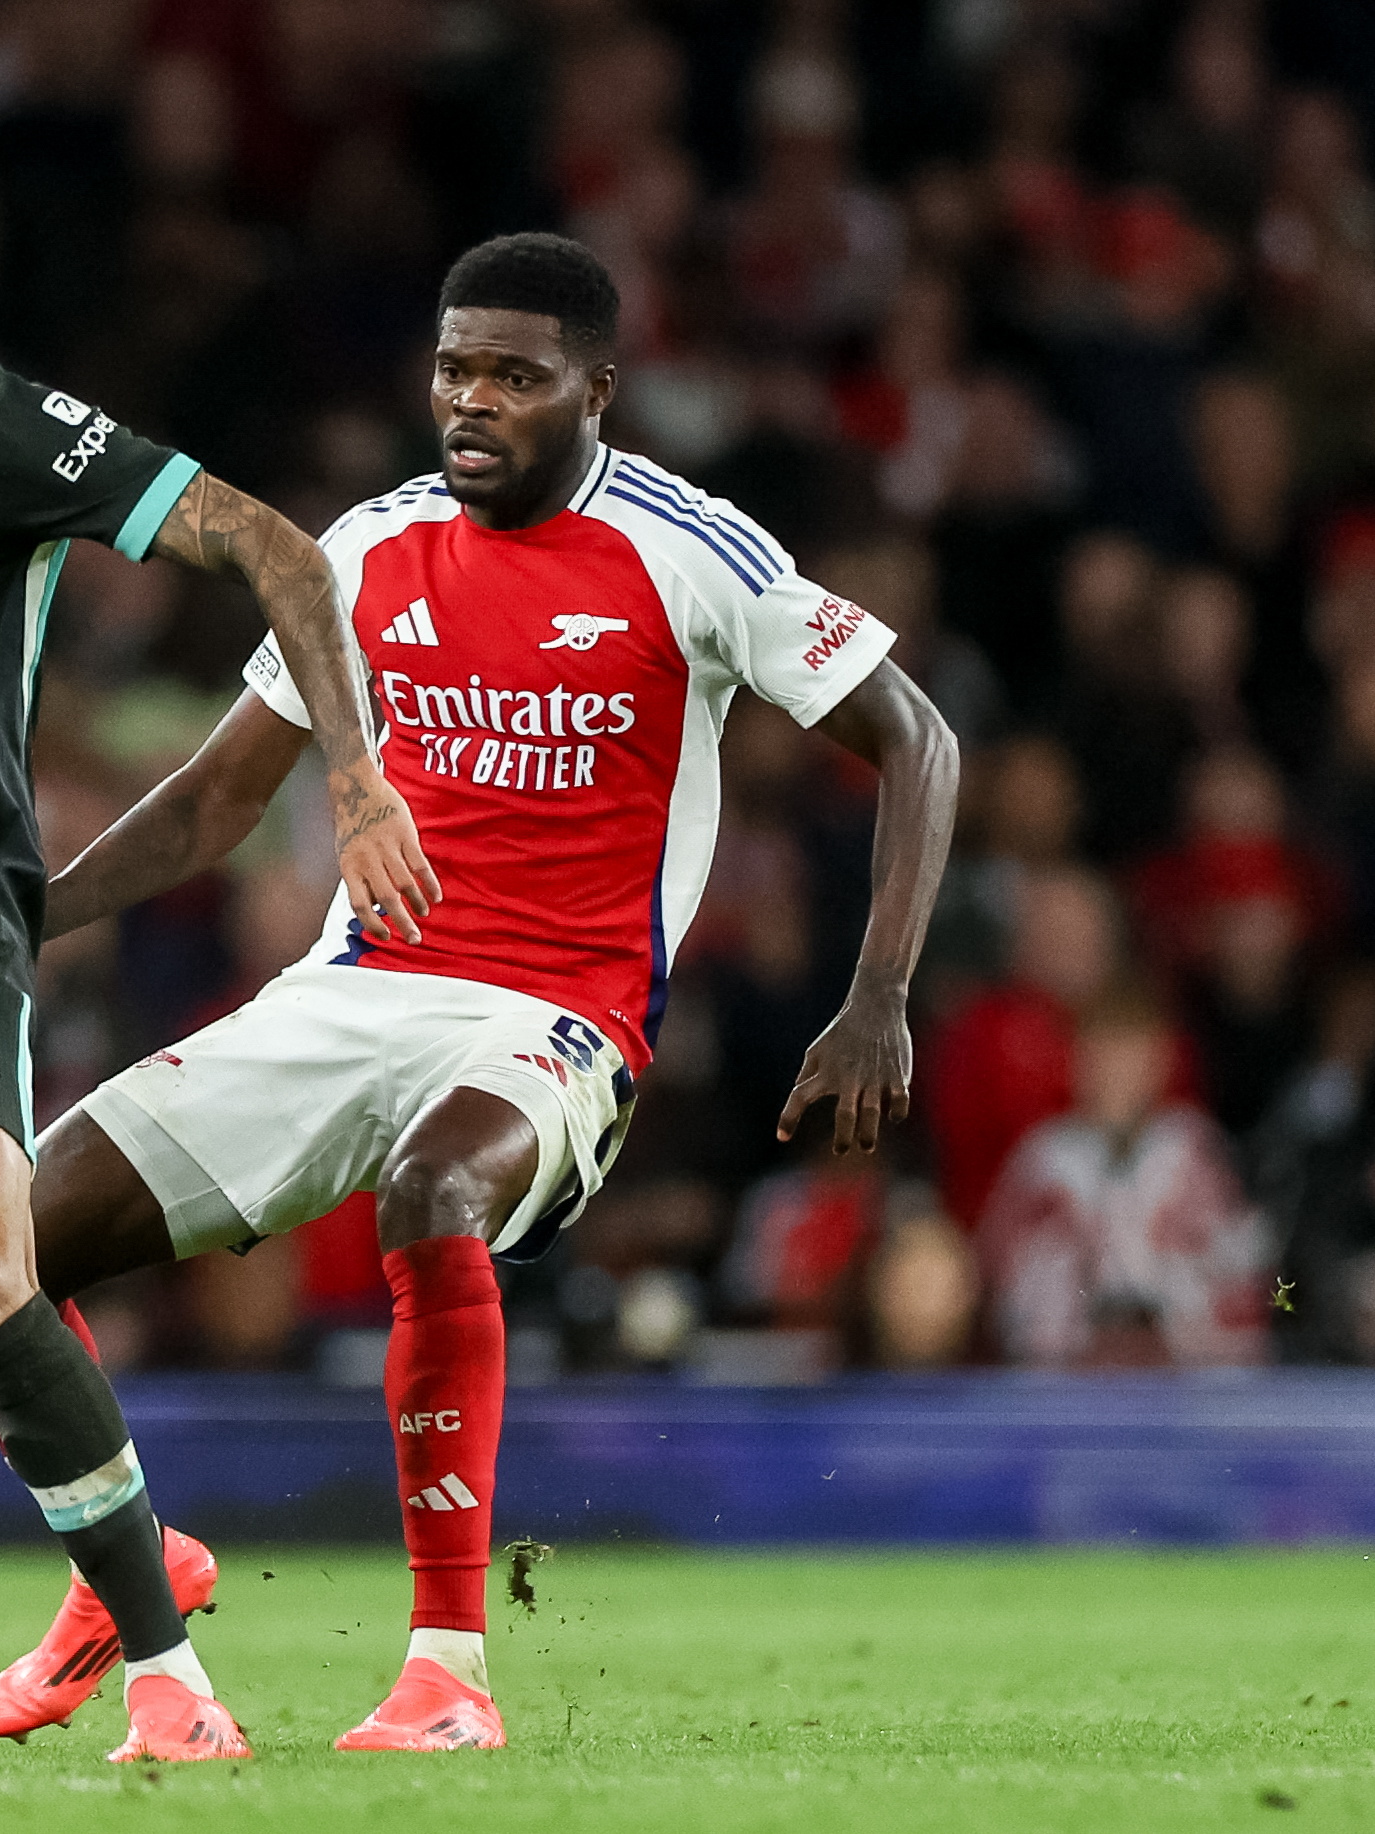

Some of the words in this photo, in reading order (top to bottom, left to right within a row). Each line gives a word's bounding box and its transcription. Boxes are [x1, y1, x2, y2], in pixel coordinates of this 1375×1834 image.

[52, 407, 118, 482] Expe
[804, 594, 845, 632] VISI
[382, 670, 635, 737] Emirates
[421, 733, 472, 778] FLY
[472, 738, 595, 790] BETTER
[546, 1015, 605, 1073] 5
[400, 1409, 462, 1434] AFC
